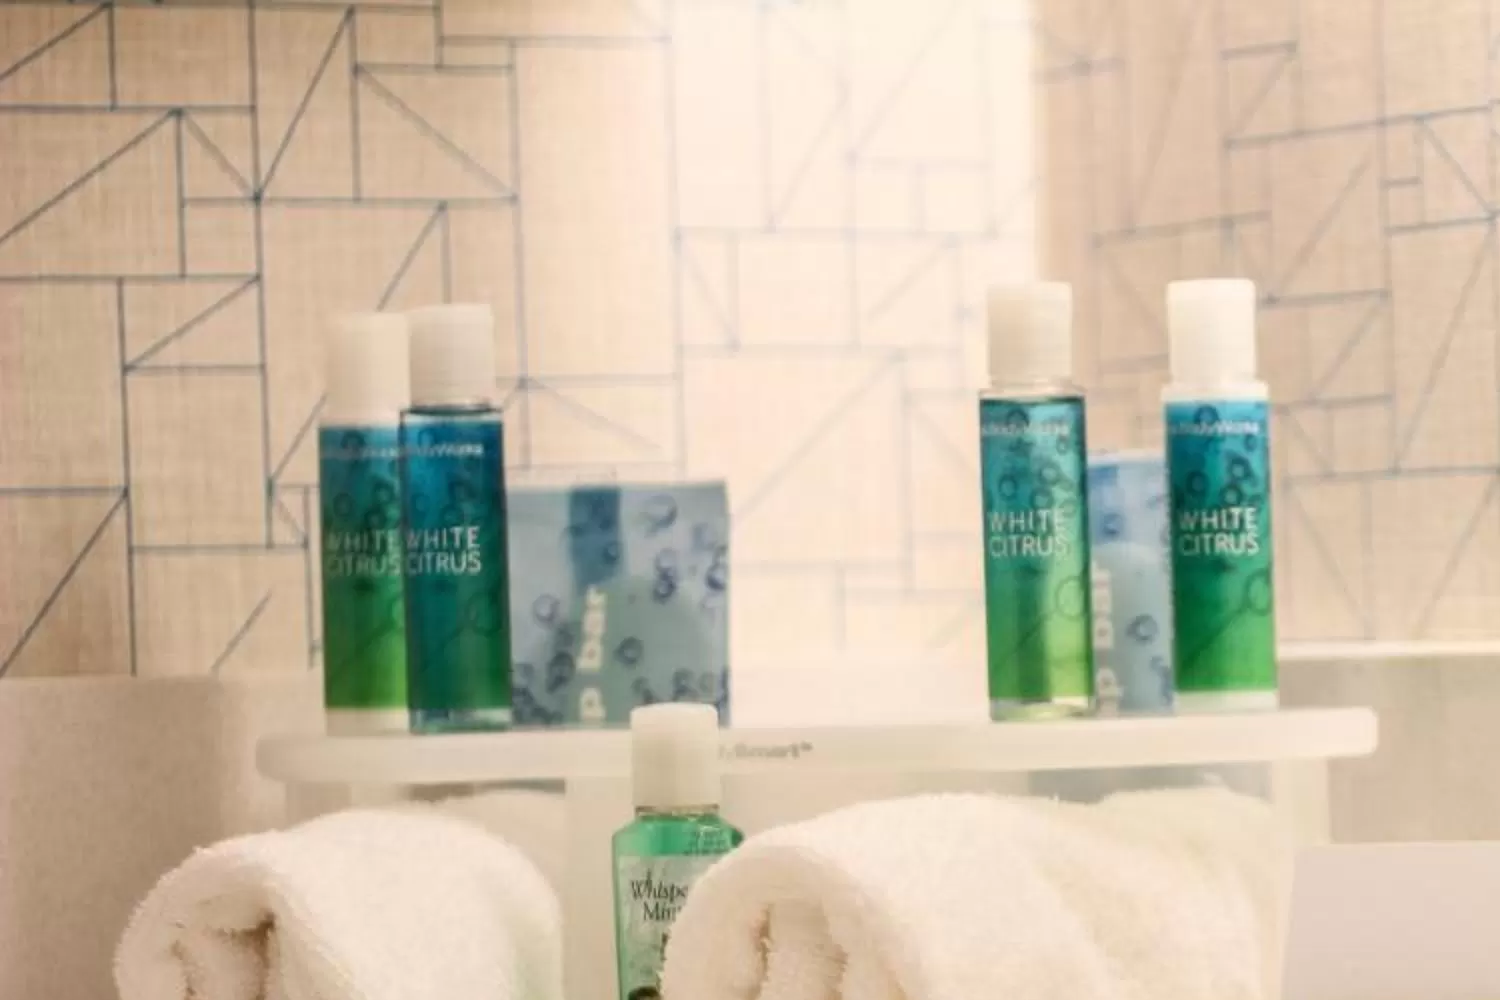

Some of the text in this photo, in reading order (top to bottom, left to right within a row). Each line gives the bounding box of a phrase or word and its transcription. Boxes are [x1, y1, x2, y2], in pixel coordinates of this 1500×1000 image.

[987, 508, 1066, 534] WHITE
[1180, 506, 1257, 532] WHITE
[326, 527, 399, 553] WHITE
[406, 525, 480, 551] WHITE
[989, 533, 1069, 558] CITRUS
[1181, 532, 1259, 557] CITRUS
[407, 549, 483, 577] CITRUS
[630, 868, 689, 903] Whispe
